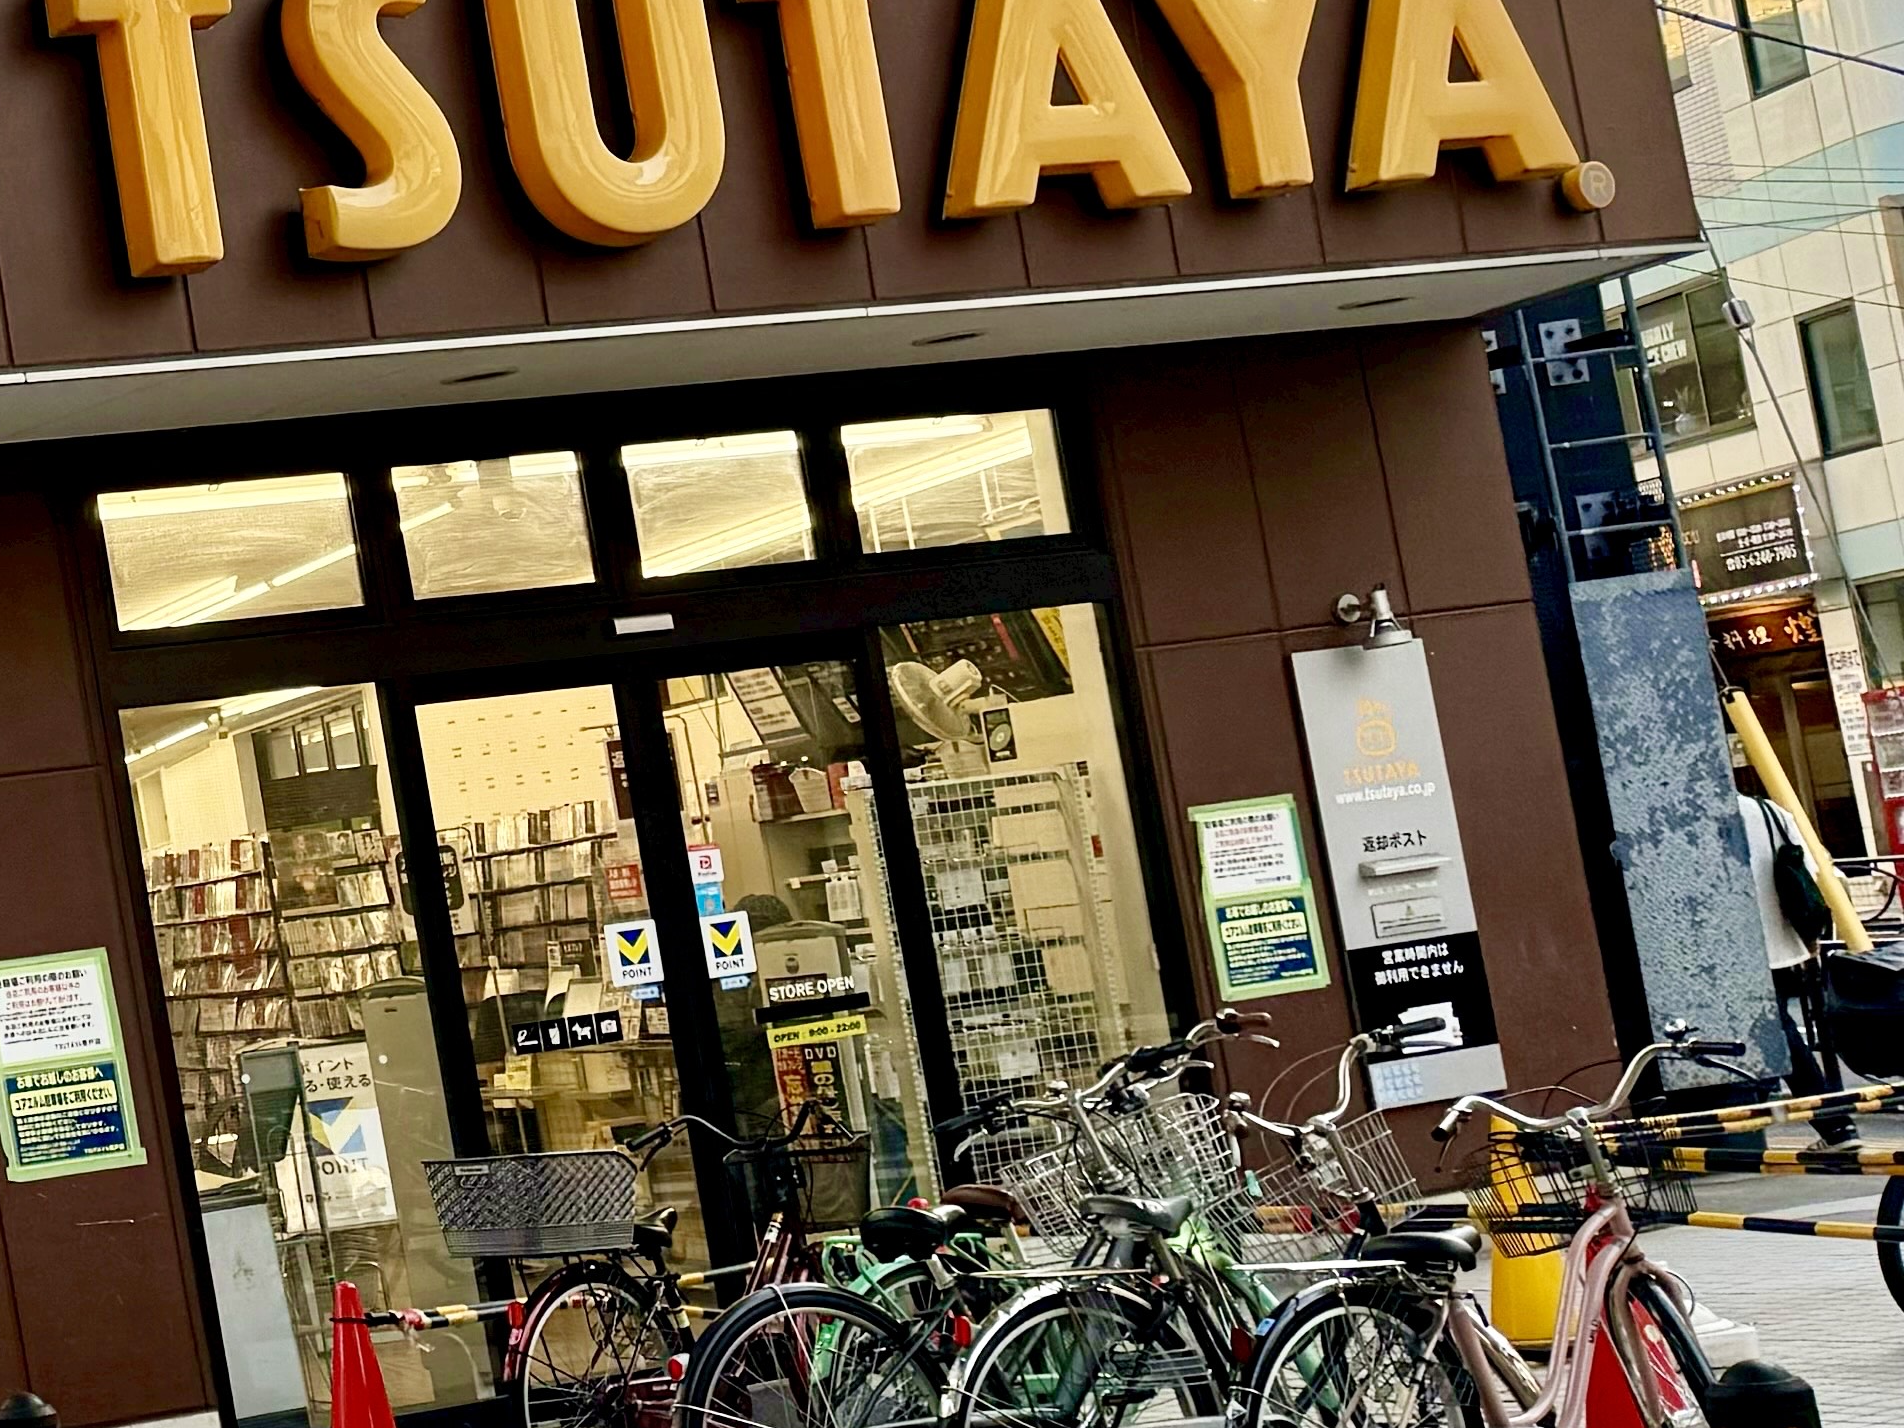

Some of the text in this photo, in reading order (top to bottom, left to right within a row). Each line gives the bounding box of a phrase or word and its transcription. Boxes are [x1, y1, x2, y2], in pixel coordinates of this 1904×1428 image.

[1335, 781, 1436, 805] www.tsutaya.co.jp
[1362, 829, 1427, 853] 返却ポスト
[715, 958, 745, 971] POINT
[1381, 942, 1449, 965] 営業時間内は
[622, 967, 652, 980] POINT
[1374, 960, 1465, 986] 御利用できません
[769, 976, 855, 1002] STORE OPEN
[804, 1046, 837, 1060] DVD
